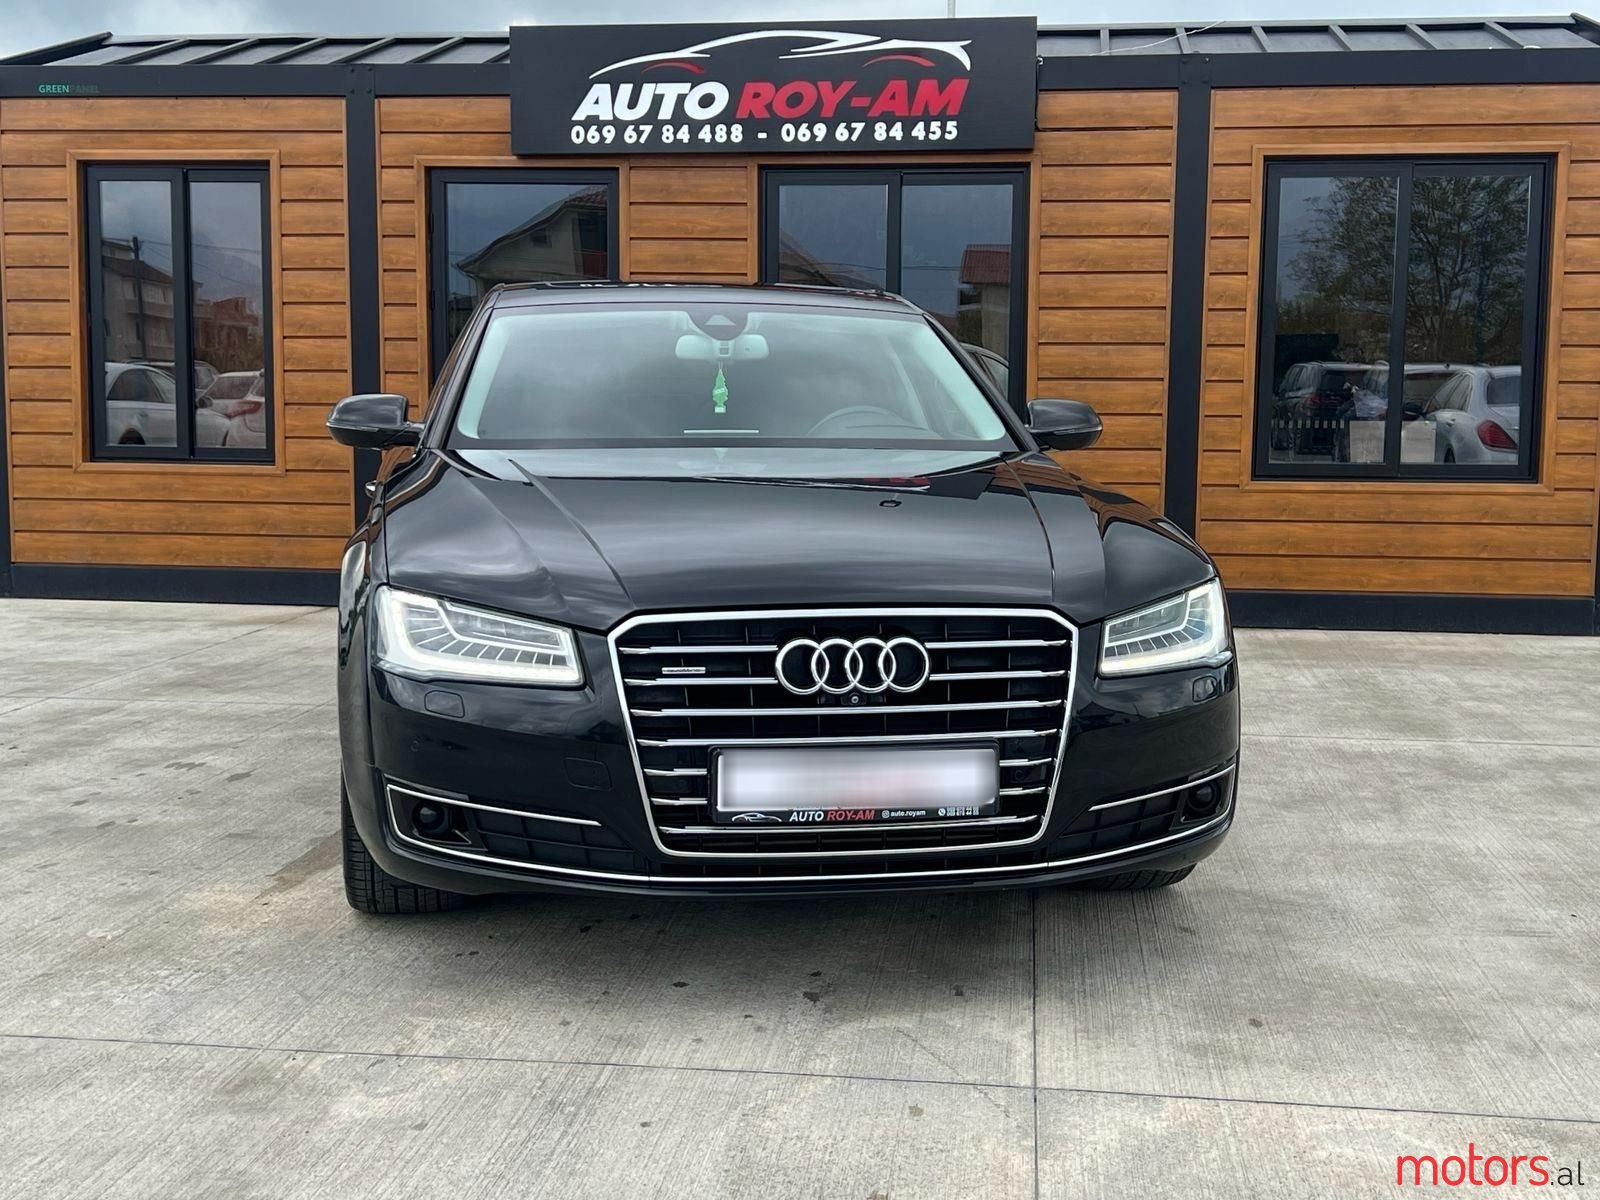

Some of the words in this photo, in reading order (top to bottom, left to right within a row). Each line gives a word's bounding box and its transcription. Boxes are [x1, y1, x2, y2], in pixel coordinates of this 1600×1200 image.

[571, 82, 730, 121] AUTO
[736, 78, 970, 120] ROY-AM
[571, 124, 616, 145] 069
[624, 124, 653, 145] 67
[661, 124, 690, 144] 84
[698, 123, 744, 144] 488
[757, 131, 768, 139] -
[781, 123, 827, 143] 069
[835, 122, 865, 142] 67
[873, 121, 903, 142] 84
[911, 121, 958, 141] 455
[789, 811, 825, 823] AUTO
[827, 809, 876, 822] ROY-AM
[891, 810, 926, 818] auto.royam
